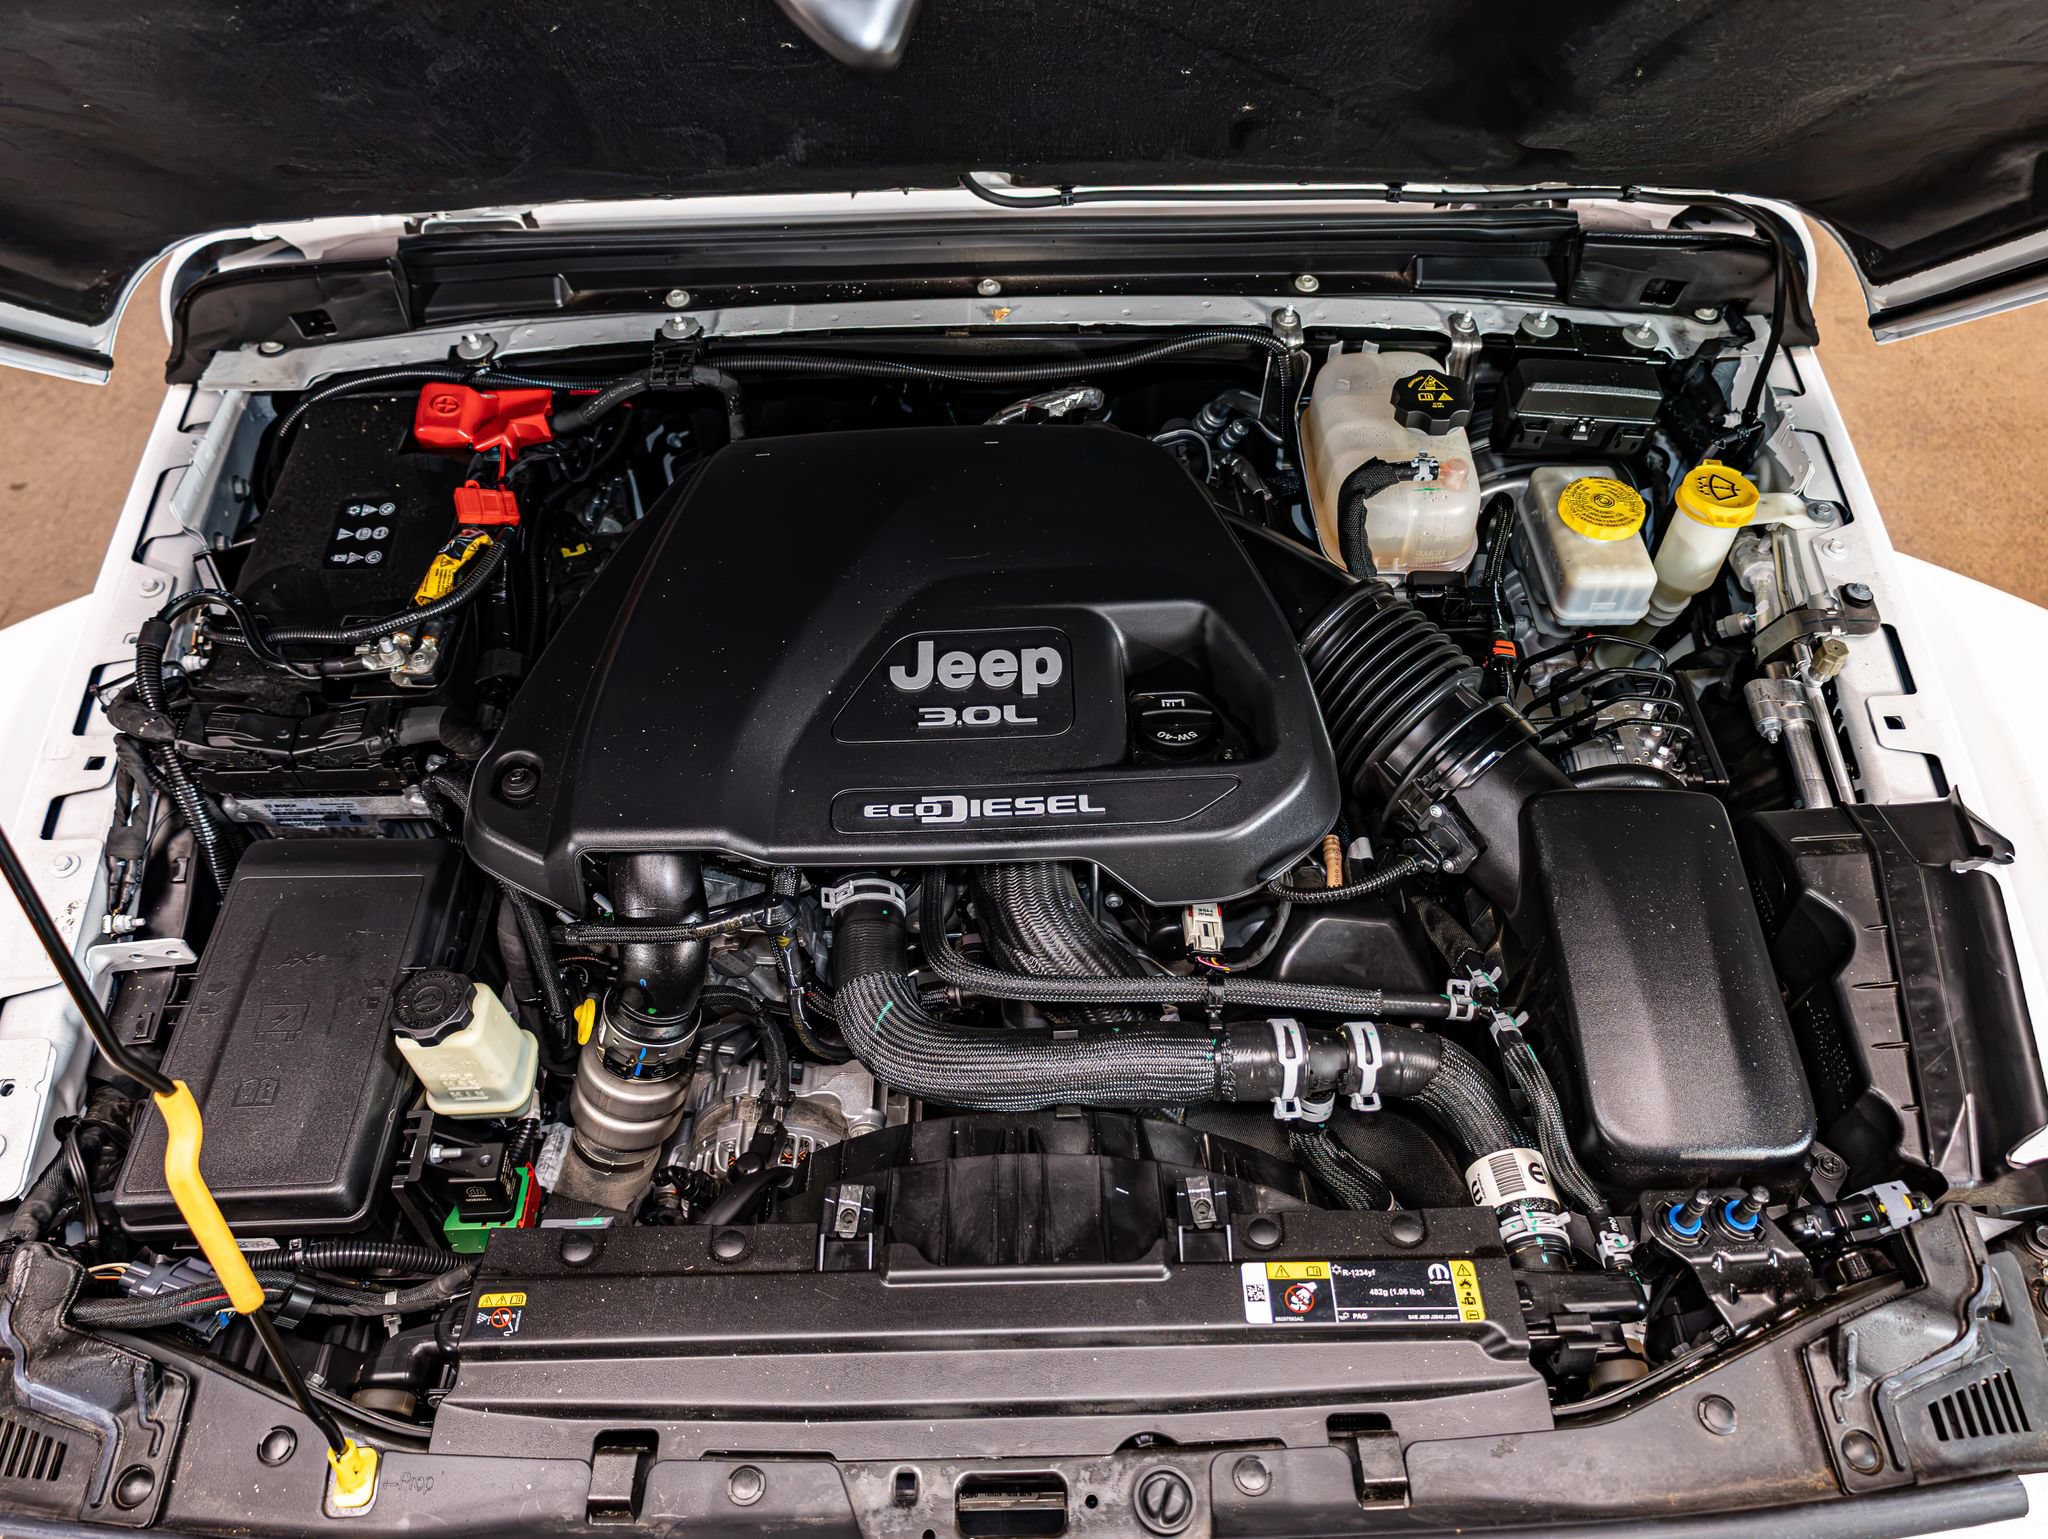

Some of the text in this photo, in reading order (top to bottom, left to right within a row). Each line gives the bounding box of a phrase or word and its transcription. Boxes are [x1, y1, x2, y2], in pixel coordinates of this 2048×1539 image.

[889, 640, 1063, 698] Jeep
[918, 705, 1038, 729] 3.0L
[1156, 730, 1198, 742] 5W-40
[450, 1090, 486, 1098] MIN
[1342, 1269, 1376, 1277] R-1234yf
[1409, 1288, 1425, 1297] lbs)
